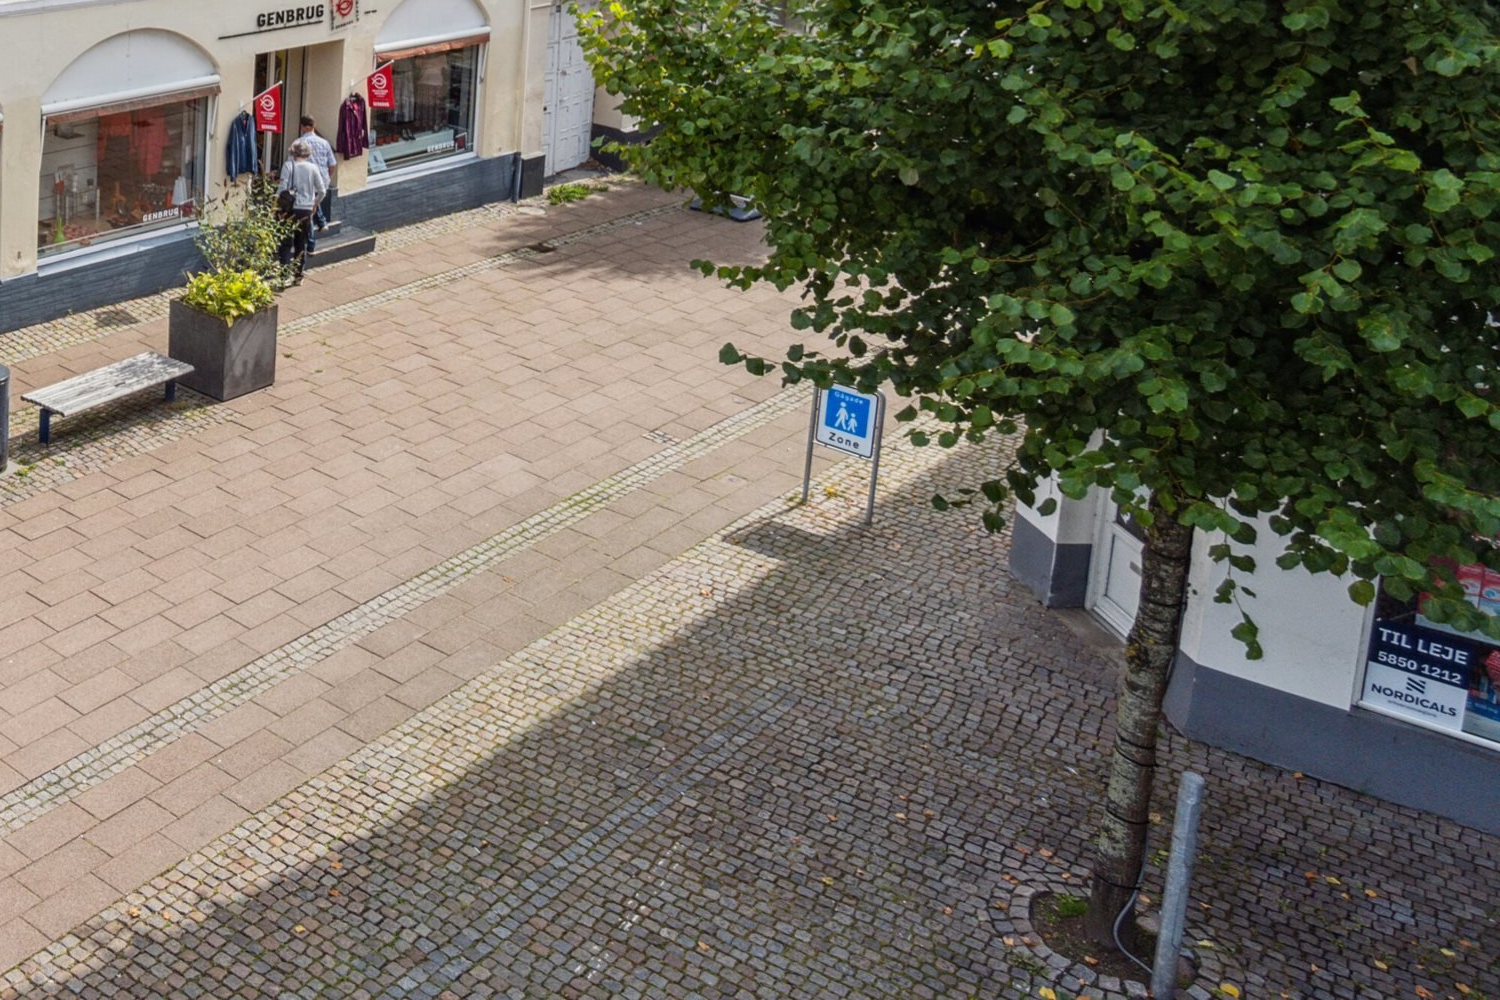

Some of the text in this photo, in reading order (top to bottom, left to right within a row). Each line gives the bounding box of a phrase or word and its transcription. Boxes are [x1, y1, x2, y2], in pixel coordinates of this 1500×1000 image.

[257, 4, 324, 28] GENBRUG
[142, 207, 180, 222] GENBRUG
[829, 432, 859, 448] Zone
[1378, 627, 1412, 649] TIL
[1417, 640, 1469, 665] LEJE
[1378, 651, 1461, 684] 5850 1212
[1372, 685, 1456, 716] NORDICALS
